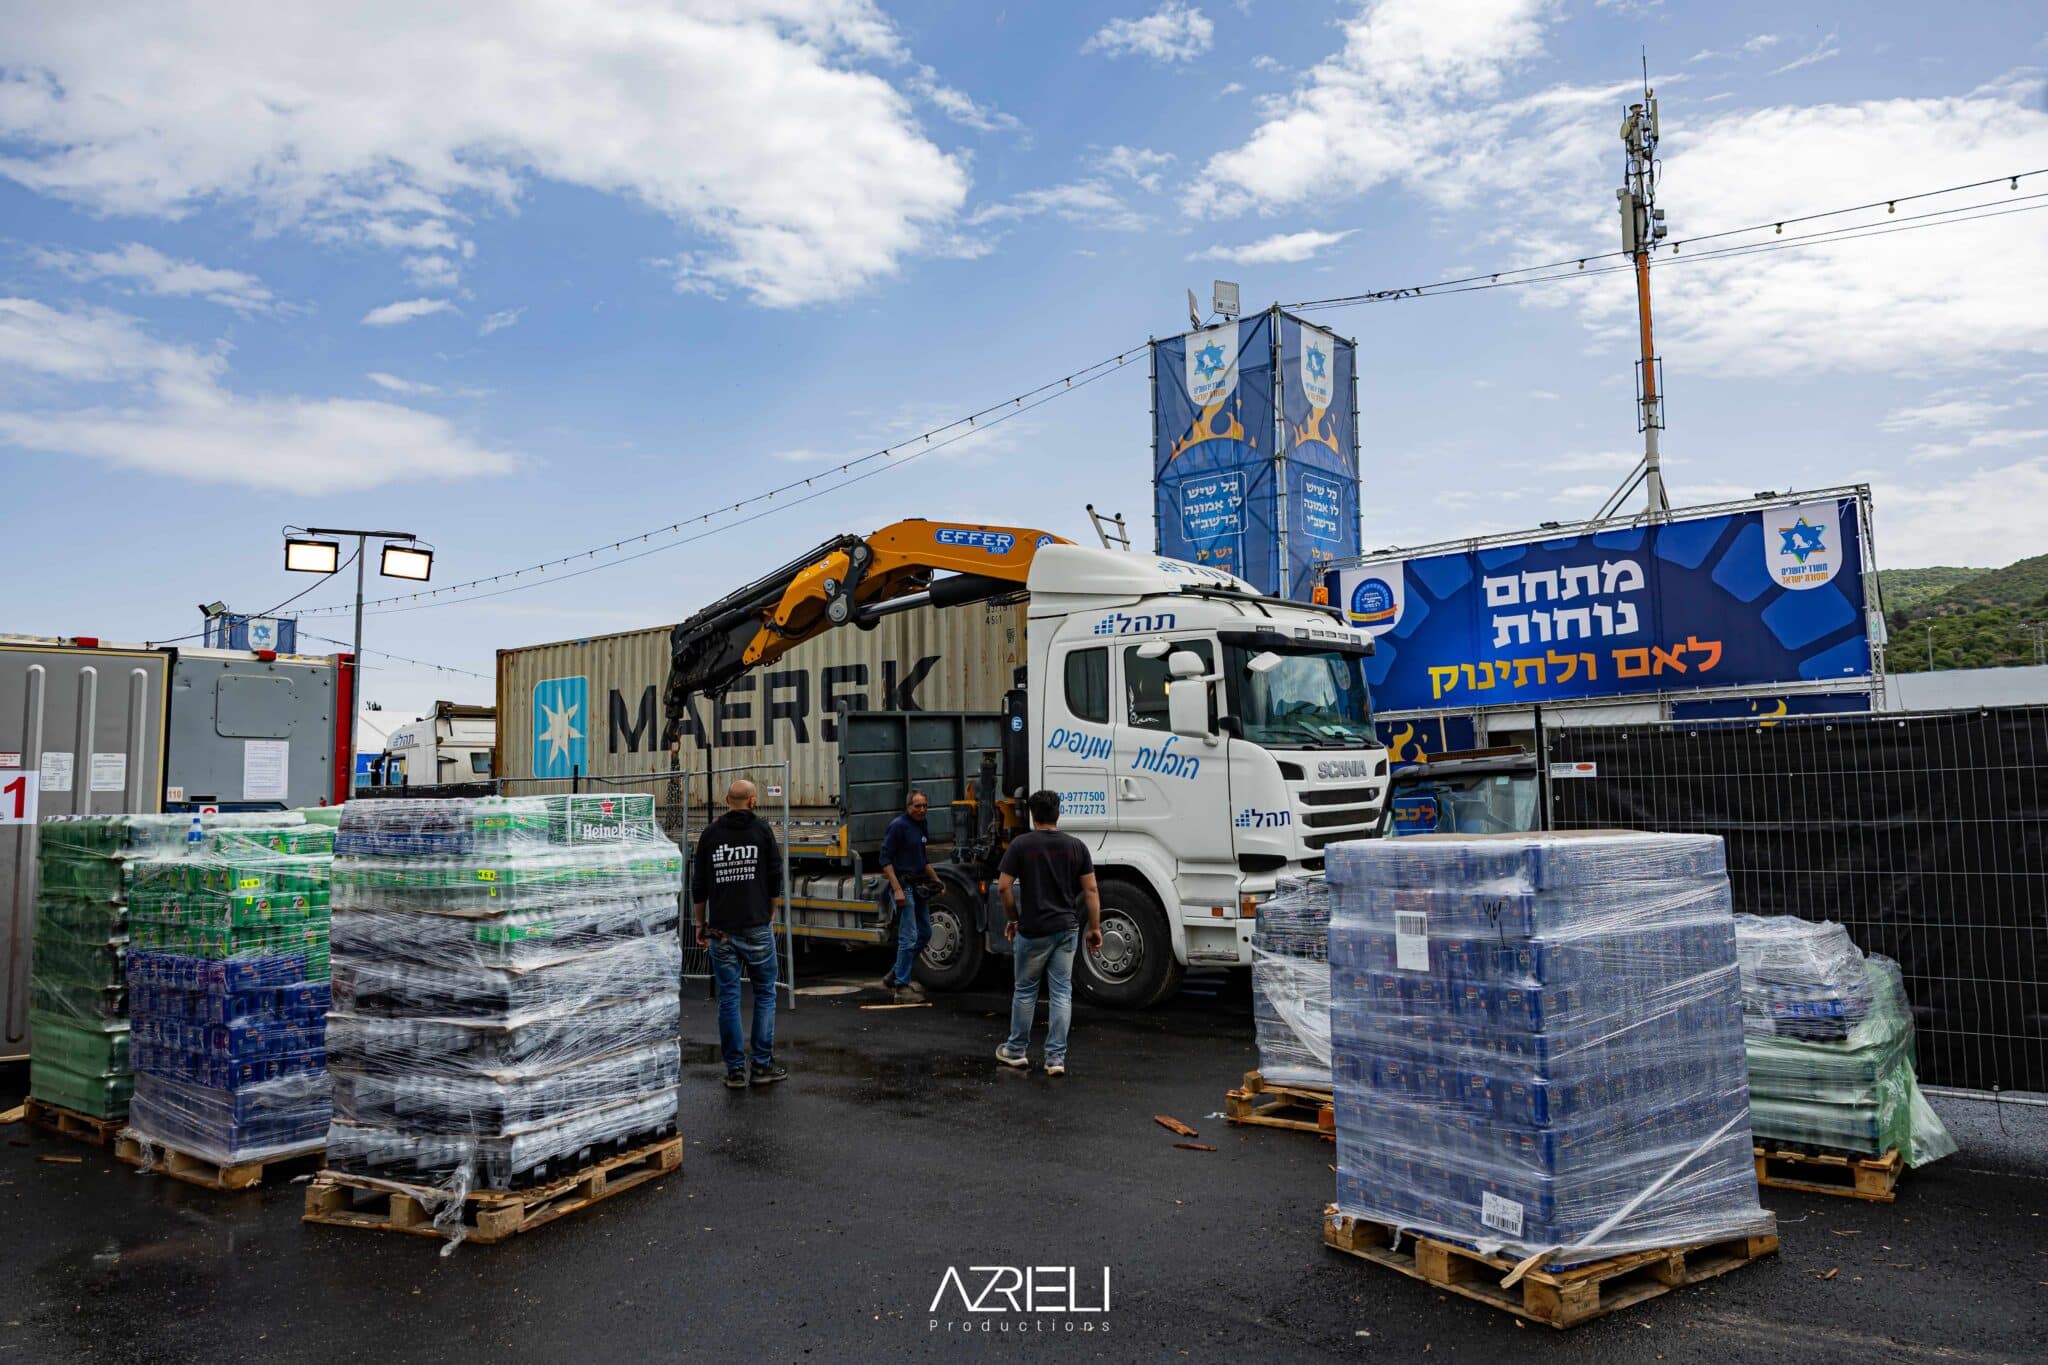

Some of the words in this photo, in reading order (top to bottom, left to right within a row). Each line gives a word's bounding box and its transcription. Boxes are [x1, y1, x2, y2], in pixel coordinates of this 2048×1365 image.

[1187, 483, 1217, 498] שיש
[1220, 481, 1239, 493] כל
[1184, 500, 1224, 516] אמונה
[1227, 495, 1242, 507] לו
[940, 530, 1011, 547] EFFER
[1482, 559, 1645, 608] מתחם
[1116, 612, 1176, 633] תהל
[1492, 600, 1639, 649] נוחות
[1611, 635, 1722, 678] לאם
[1427, 649, 1597, 700] ולתינוק
[608, 655, 942, 753] MAERSK
[1047, 727, 1113, 760] ומנופים
[1131, 736, 1200, 780] הובלות
[1317, 760, 1368, 780] SCANIA
[3, 776, 26, 819] 1
[1252, 808, 1291, 828] תהל
[724, 844, 758, 860] תהל
